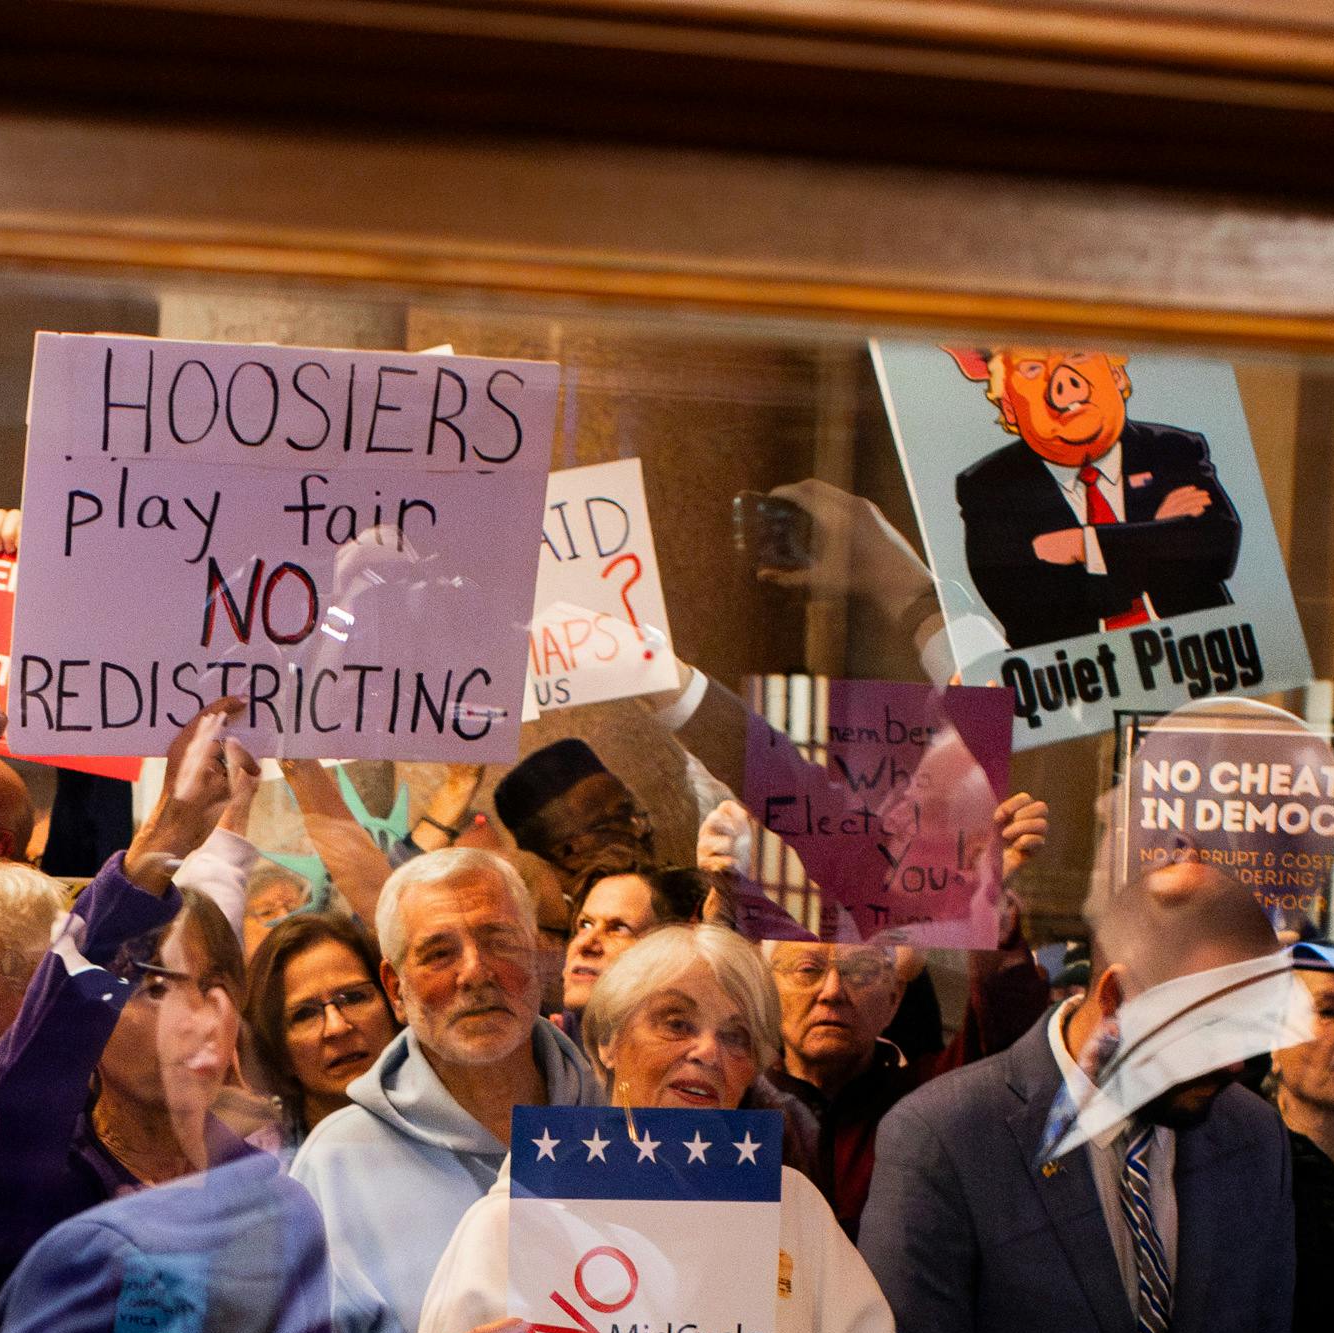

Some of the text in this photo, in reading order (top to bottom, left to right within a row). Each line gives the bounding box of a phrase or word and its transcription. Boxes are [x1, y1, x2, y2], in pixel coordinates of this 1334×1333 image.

[101, 346, 525, 465] HOOSIERS
[65, 465, 438, 564] play fair
[200, 556, 320, 648] NO
[527, 610, 619, 677] APS
[19, 654, 509, 743] REDISTRICTING
[1001, 622, 1266, 730] Quiet Piggy
[1139, 797, 1186, 833] IN
[1141, 758, 1202, 794] NO
